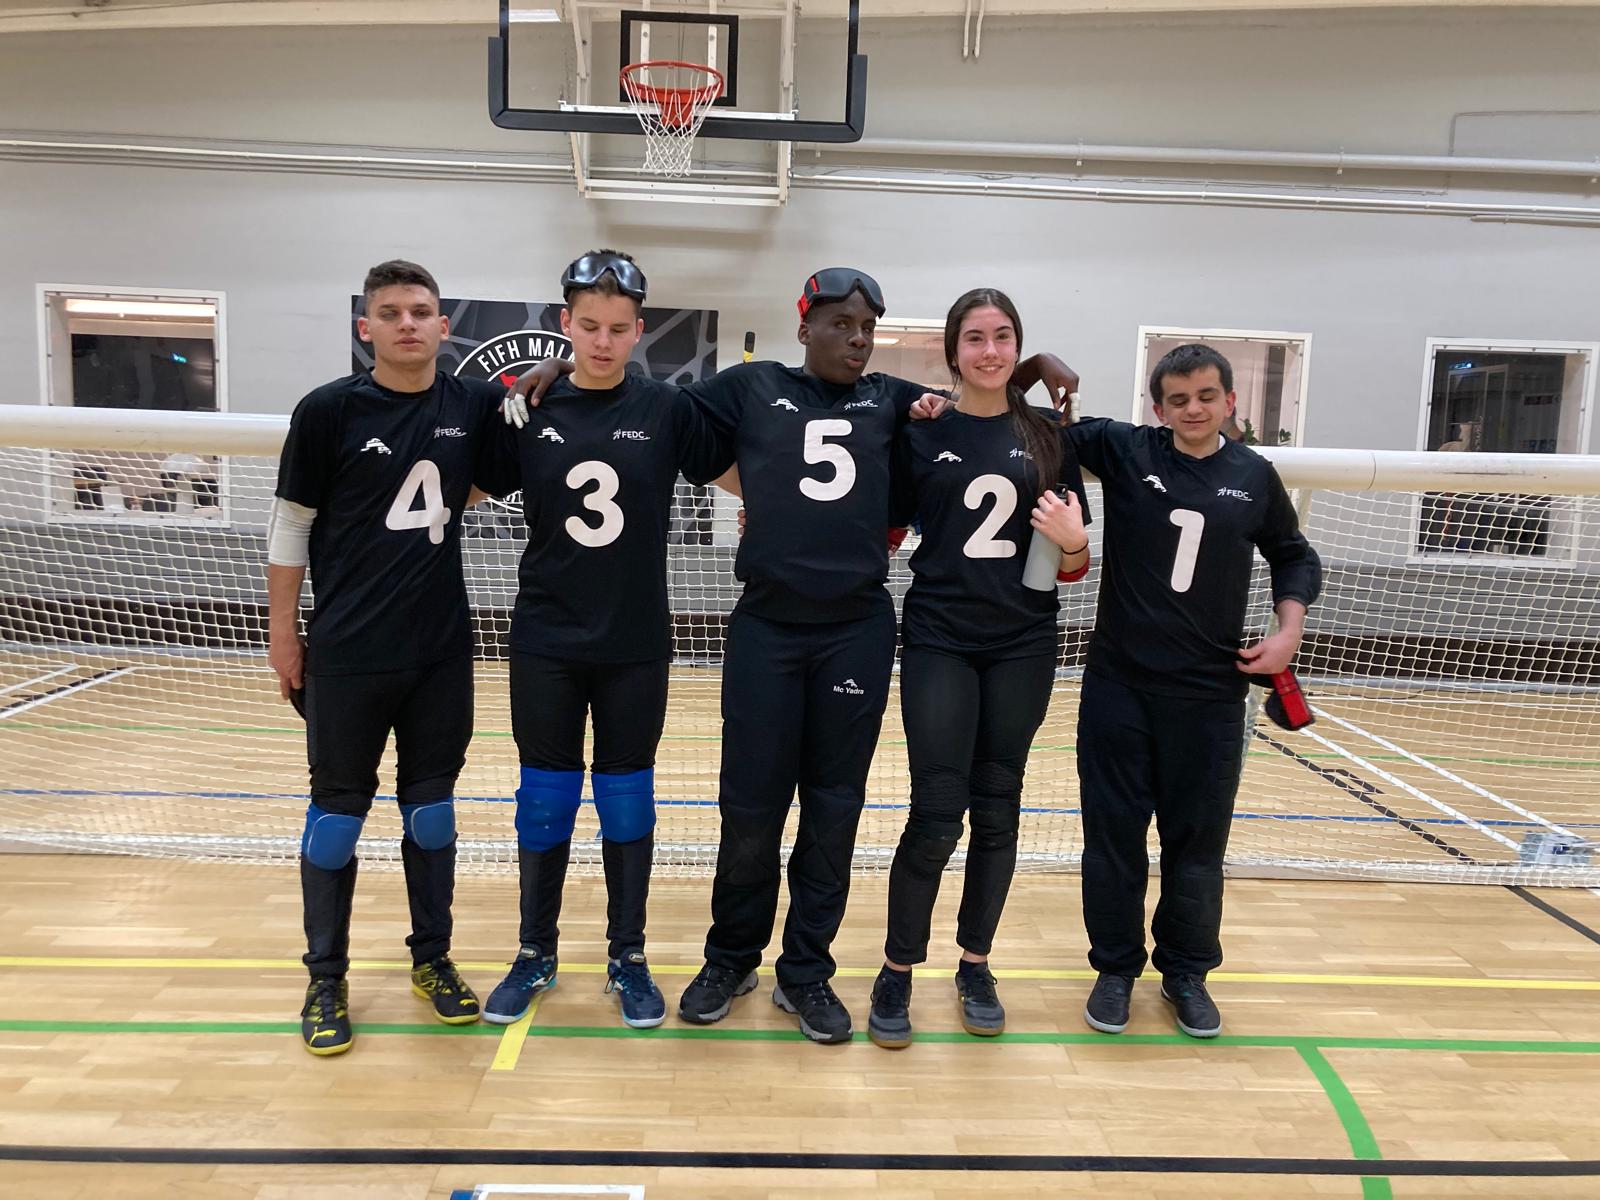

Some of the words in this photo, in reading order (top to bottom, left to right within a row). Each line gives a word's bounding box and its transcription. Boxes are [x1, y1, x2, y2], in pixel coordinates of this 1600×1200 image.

[477, 339, 521, 373] FIFH
[440, 427, 462, 436] FEDC
[621, 430, 645, 439] FEDC
[799, 418, 857, 502] 5
[385, 459, 452, 545] 4
[565, 460, 625, 548] 3
[963, 473, 1018, 559] 2
[1226, 489, 1249, 499] FEDC
[1169, 508, 1205, 593] 1
[833, 685, 844, 693] Mc
